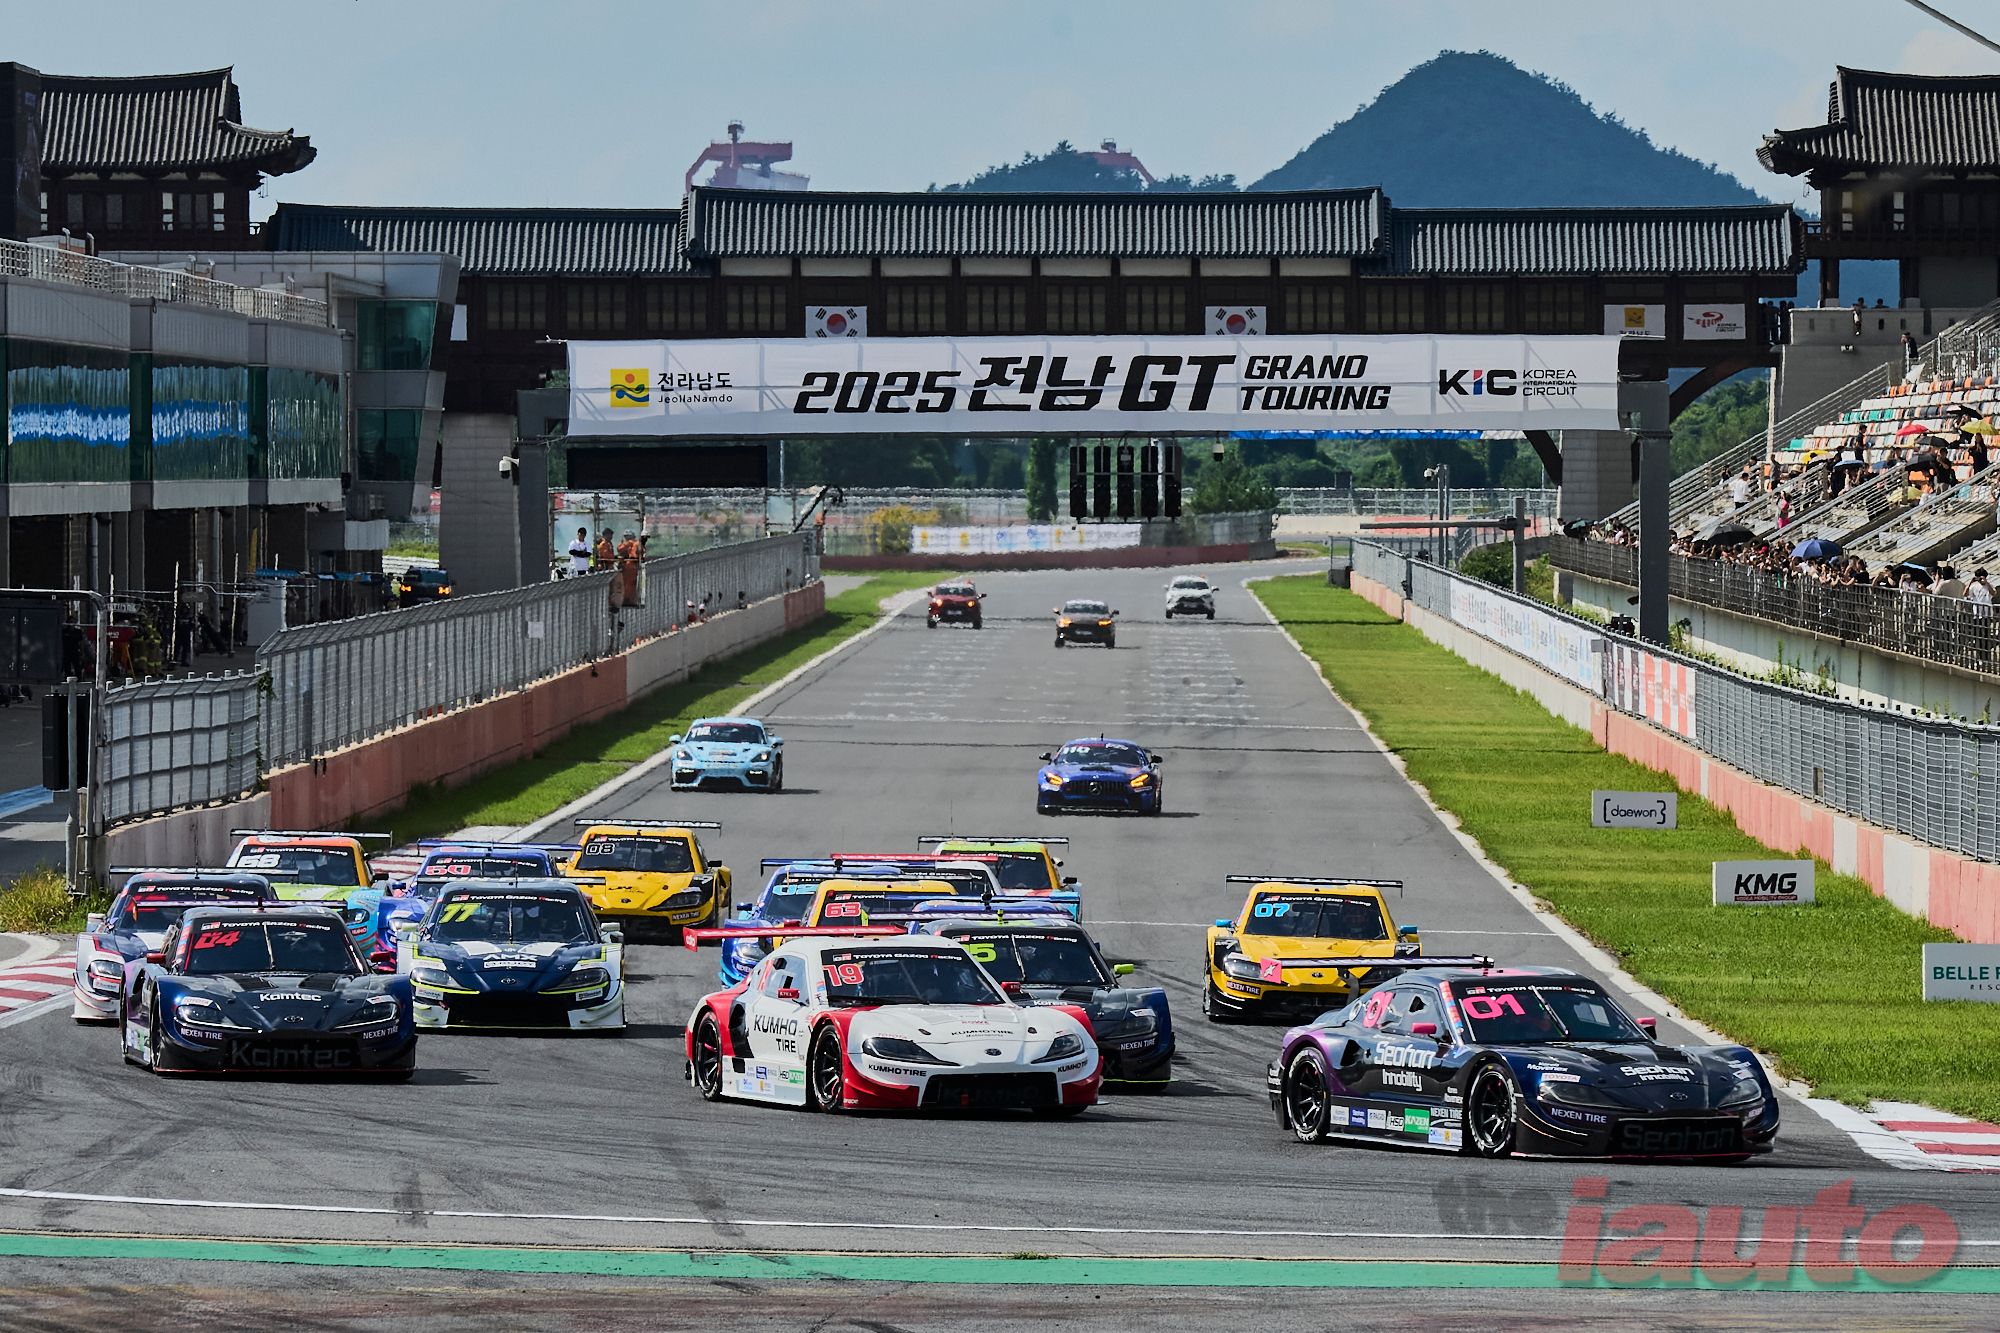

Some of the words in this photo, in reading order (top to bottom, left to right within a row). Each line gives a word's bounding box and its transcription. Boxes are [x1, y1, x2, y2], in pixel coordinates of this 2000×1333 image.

[1244, 355, 1368, 379] GRAND
[1523, 369, 1577, 379] KOREA
[657, 372, 733, 392] 전라남도
[793, 371, 961, 413] 2025
[1241, 386, 1391, 410] TOURING
[1523, 387, 1577, 396] CIRCUIT
[585, 842, 615, 855] 08
[1734, 873, 1797, 894] KMG
[439, 903, 482, 924] 11
[825, 902, 861, 917] 63
[1255, 903, 1290, 917] 07
[194, 930, 241, 950] 04
[822, 964, 865, 987] 19
[1933, 966, 1989, 980] BELLE
[260, 992, 322, 1002] Kamtec
[1462, 993, 1526, 1020] 01
[363, 1030, 386, 1040] NEXEN
[387, 1025, 399, 1035] TIRE
[753, 1014, 798, 1036] KUMHO
[181, 1027, 204, 1039] NEXEN
[204, 1031, 223, 1040] TIRE
[776, 1038, 796, 1053] TIRE
[1120, 1040, 1142, 1051] NEXEN
[1143, 1037, 1156, 1048] TIRE
[1374, 1041, 1436, 1069] Seohan
[1620, 1066, 1695, 1078] Seohan
[1551, 1108, 1582, 1120] NEXEN
[1585, 1113, 1607, 1124] TIRE
